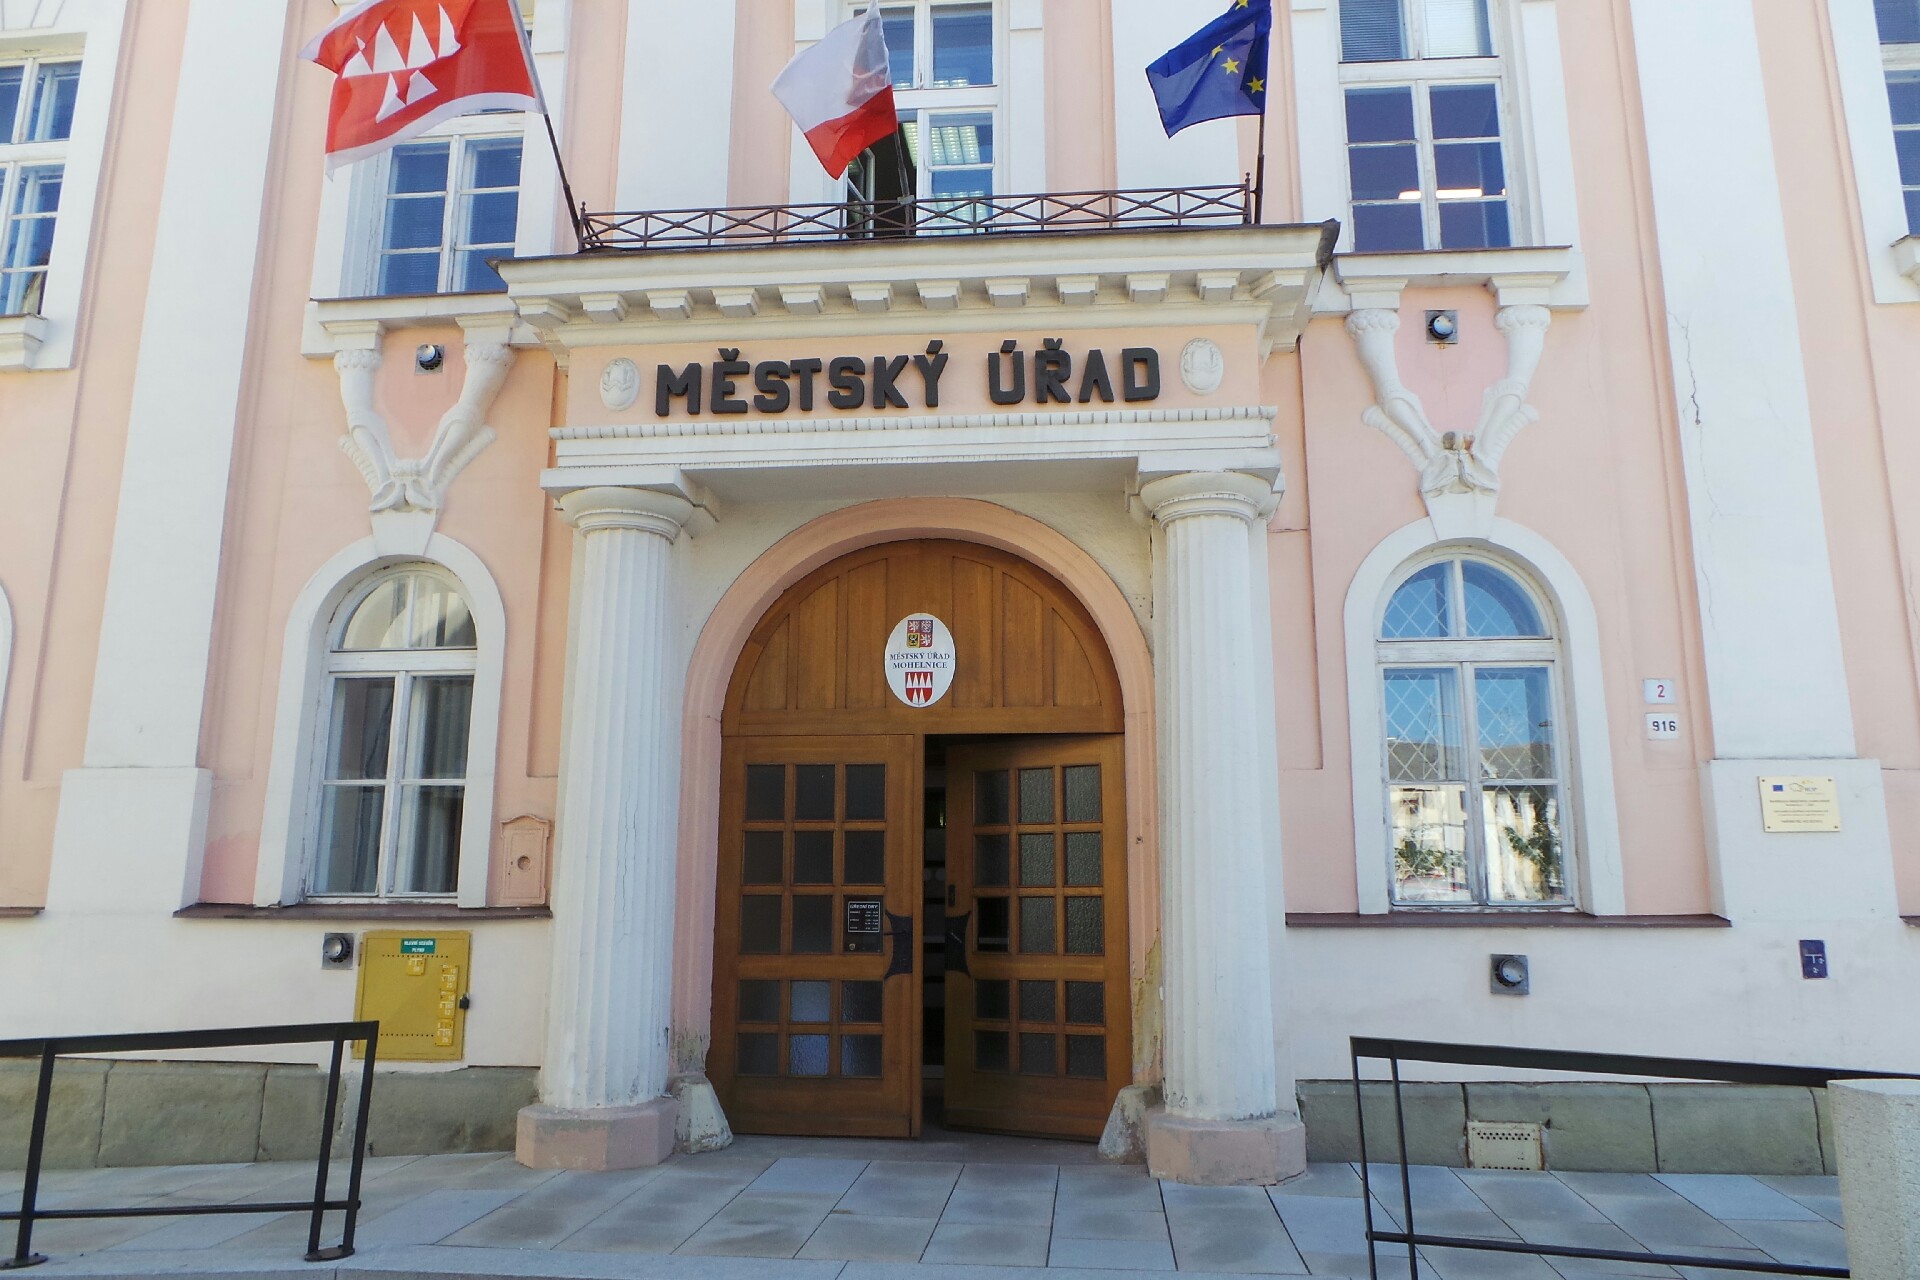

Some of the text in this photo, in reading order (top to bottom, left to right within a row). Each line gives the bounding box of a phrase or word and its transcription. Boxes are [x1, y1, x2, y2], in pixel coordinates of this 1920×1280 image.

[655, 338, 1161, 416] MĚSTSKÝ ÚŘAD
[927, 651, 950, 660] ÚŘAD
[1657, 684, 1665, 698] 2
[1652, 720, 1676, 731] 916
